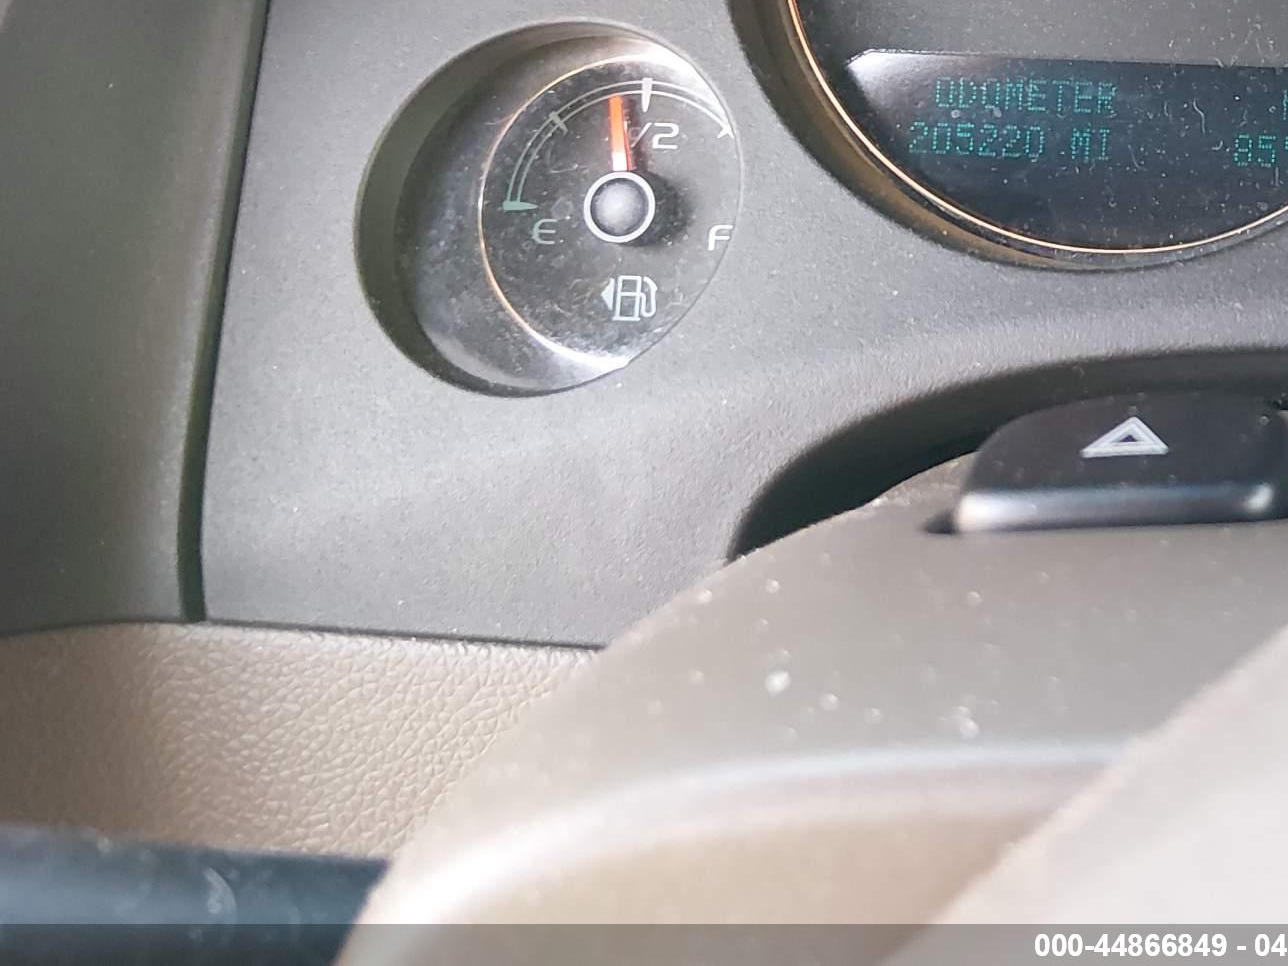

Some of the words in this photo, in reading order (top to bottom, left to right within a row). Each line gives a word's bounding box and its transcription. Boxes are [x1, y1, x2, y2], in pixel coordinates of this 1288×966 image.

[935, 77, 1116, 116] ODOMETER
[908, 121, 1046, 162] 205220
[1070, 126, 1113, 164] MI
[531, 219, 557, 245] E
[708, 224, 734, 251] F
